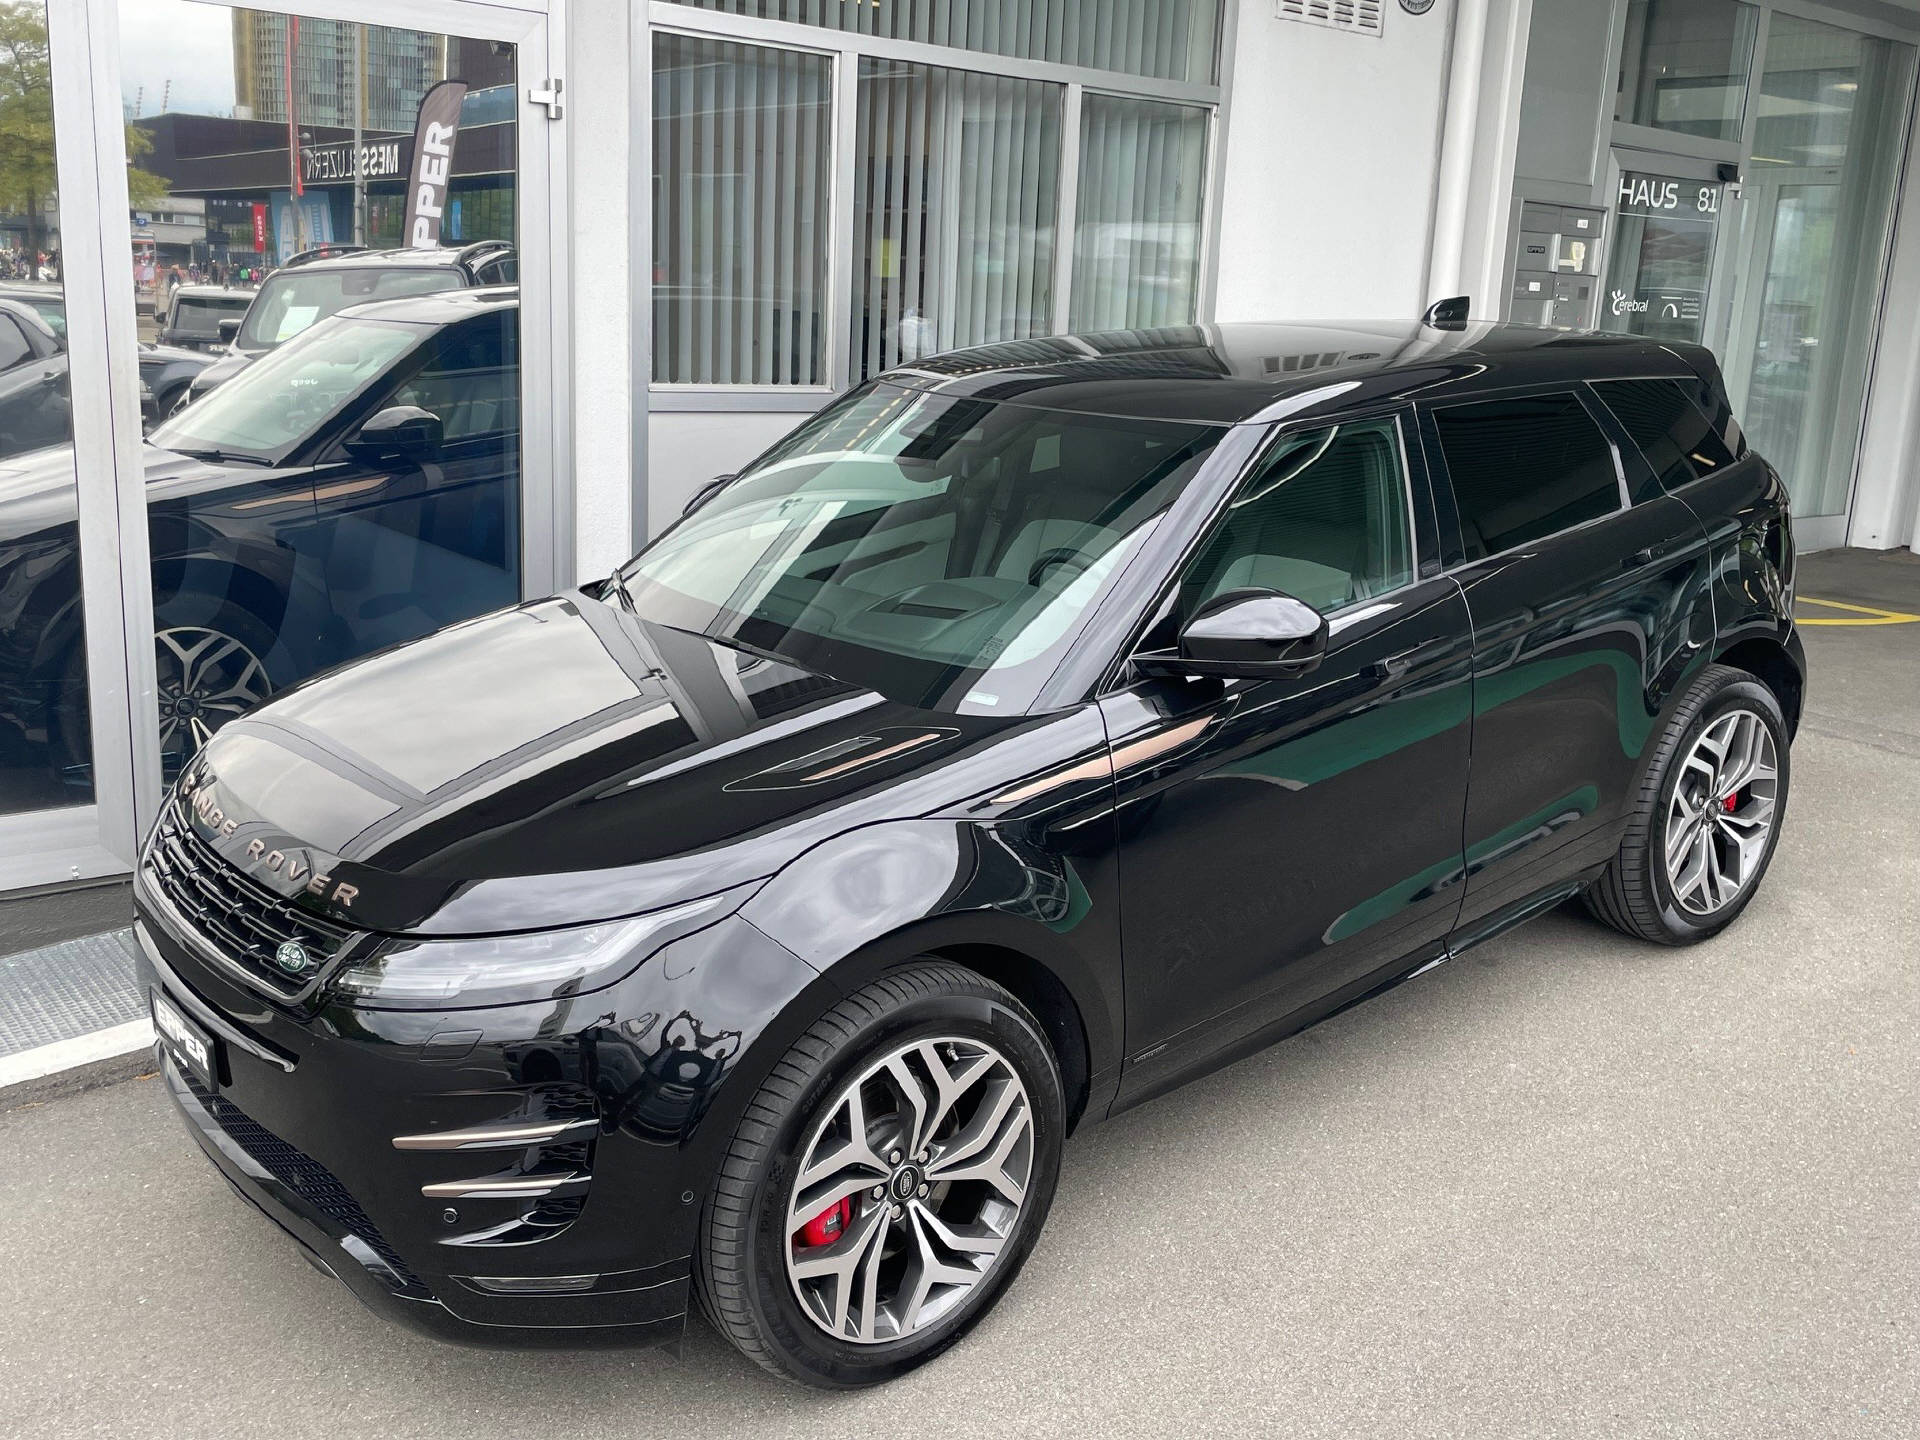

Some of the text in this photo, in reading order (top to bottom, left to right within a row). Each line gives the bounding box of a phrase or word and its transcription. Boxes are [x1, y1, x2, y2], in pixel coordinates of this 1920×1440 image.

[1617, 177, 1718, 213] HAUS 81
[1611, 295, 1649, 315] Cerebral
[184, 773, 360, 907] RANGE ROVER
